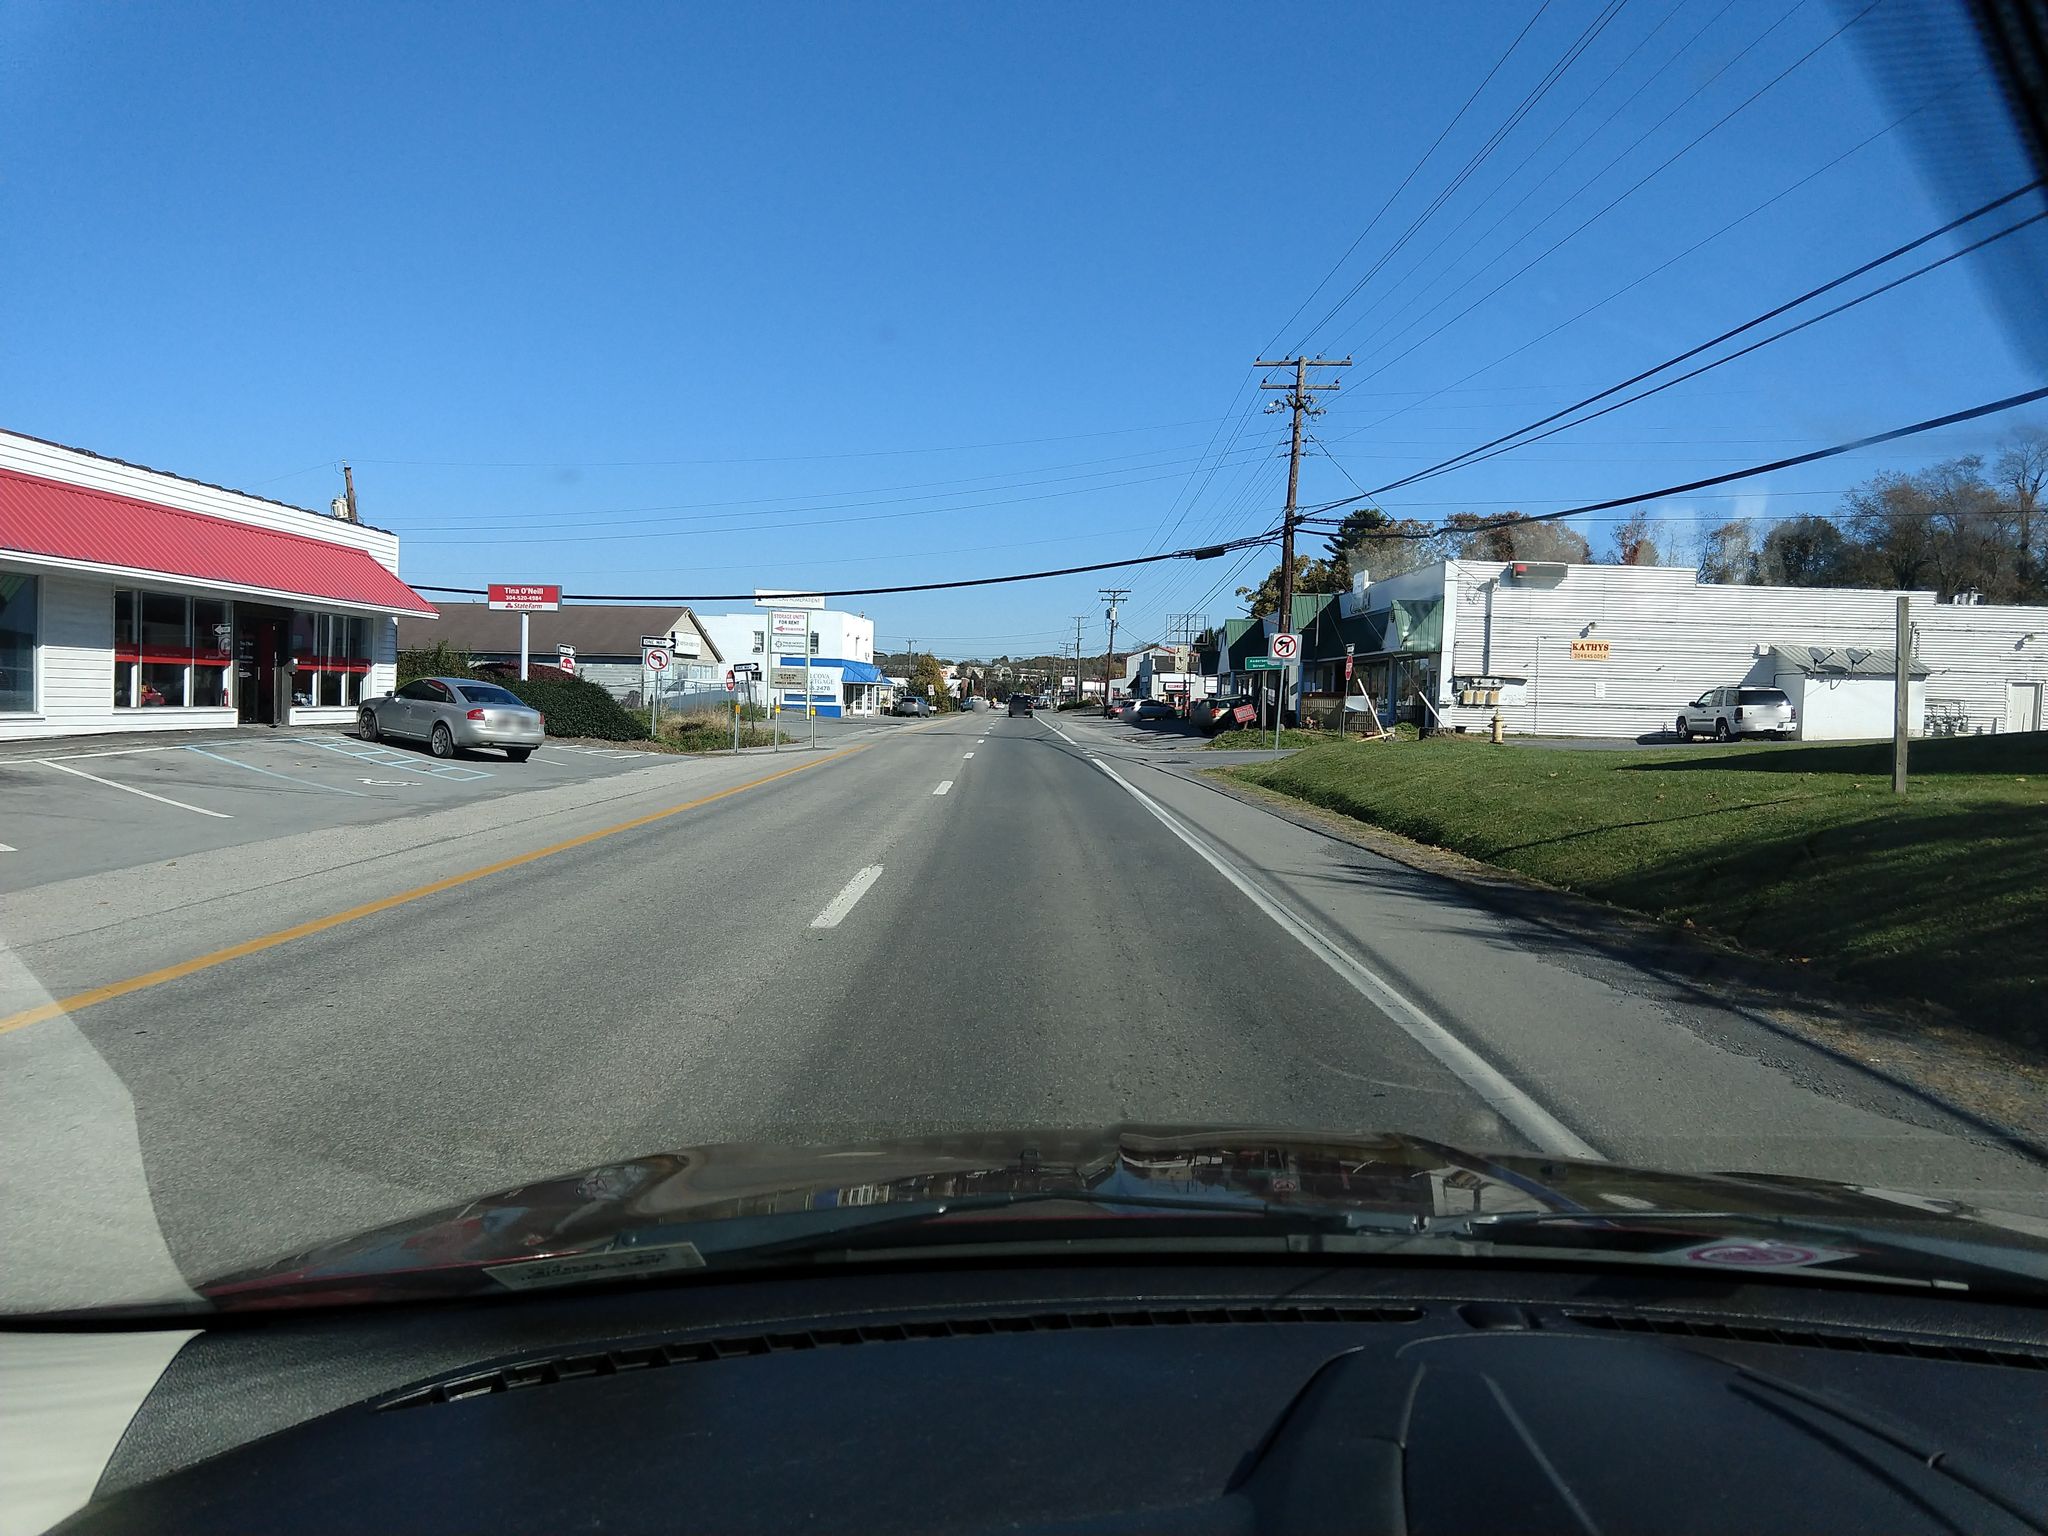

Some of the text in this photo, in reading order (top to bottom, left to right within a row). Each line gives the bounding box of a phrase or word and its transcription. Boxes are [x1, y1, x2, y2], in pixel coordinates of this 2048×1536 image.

[504, 587, 544, 595] Tina O'Neill
[1572, 643, 1609, 651] KATHYS
